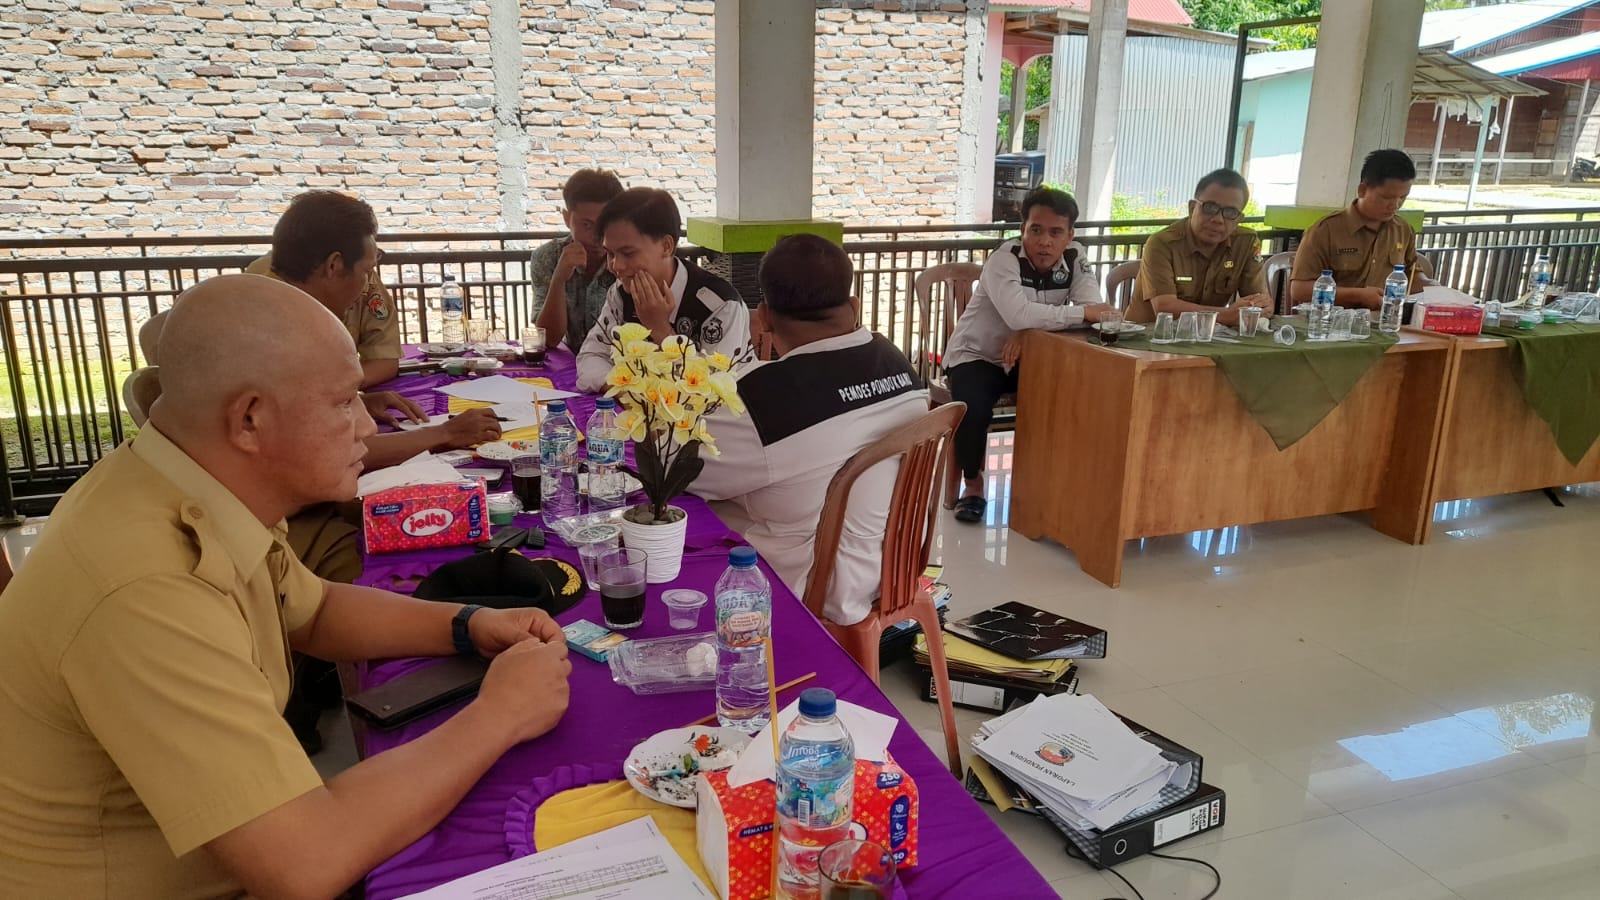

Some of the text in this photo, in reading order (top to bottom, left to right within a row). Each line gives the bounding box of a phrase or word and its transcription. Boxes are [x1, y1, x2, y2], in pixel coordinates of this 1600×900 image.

[838, 383, 871, 402] PEMDES
[870, 375, 899, 396] PONDOK
[409, 512, 447, 534] jolly
[880, 772, 900, 782] 250
[1009, 750, 1076, 786] LAPORAN PENDUDUK
